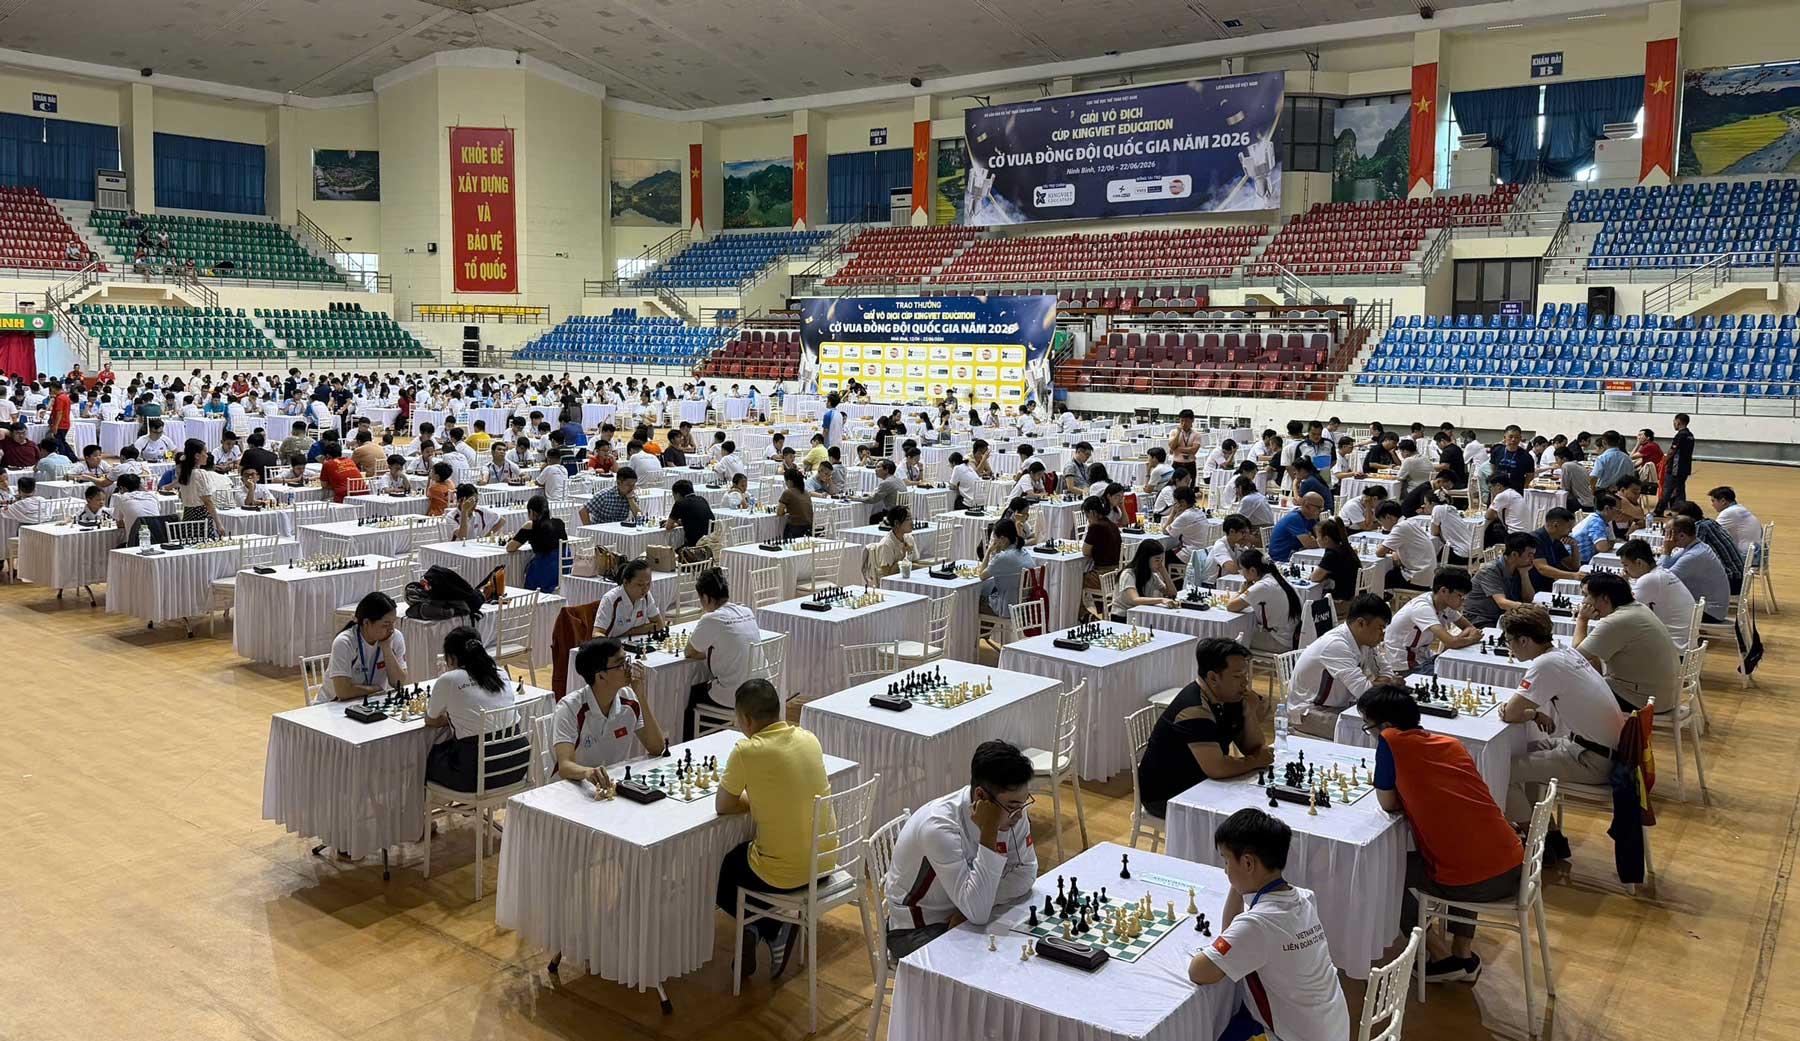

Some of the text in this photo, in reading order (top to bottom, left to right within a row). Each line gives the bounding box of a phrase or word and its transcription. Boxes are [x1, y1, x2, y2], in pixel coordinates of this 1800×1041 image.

[1080, 106, 1143, 124] GIẢI VÔ ĐỊCH
[1052, 118, 1174, 141] CÚP KINGVIET EDUCATION
[461, 140, 504, 164] KHỎE ĐỂ
[988, 131, 1250, 168] CỜ VUA ĐỒNG ĐỘI QUỐC GIA NĂM 2026
[1067, 167, 1080, 175] Ninh
[1097, 164, 1114, 173] 12/06
[1120, 161, 1156, 171] 22/06/2026
[458, 172, 509, 197] XÂY DỰNG
[477, 202, 491, 222] VÀ
[467, 228, 503, 255] BẢO VỆ
[464, 255, 507, 281] TỔ QUỐC
[914, 300, 941, 309] THƯỞNG
[829, 320, 1014, 335] CỜ VUA ĐỒNG ĐỘI QUỐC GIA NĂM 2026
[1282, 943, 1300, 951] LIÊN
